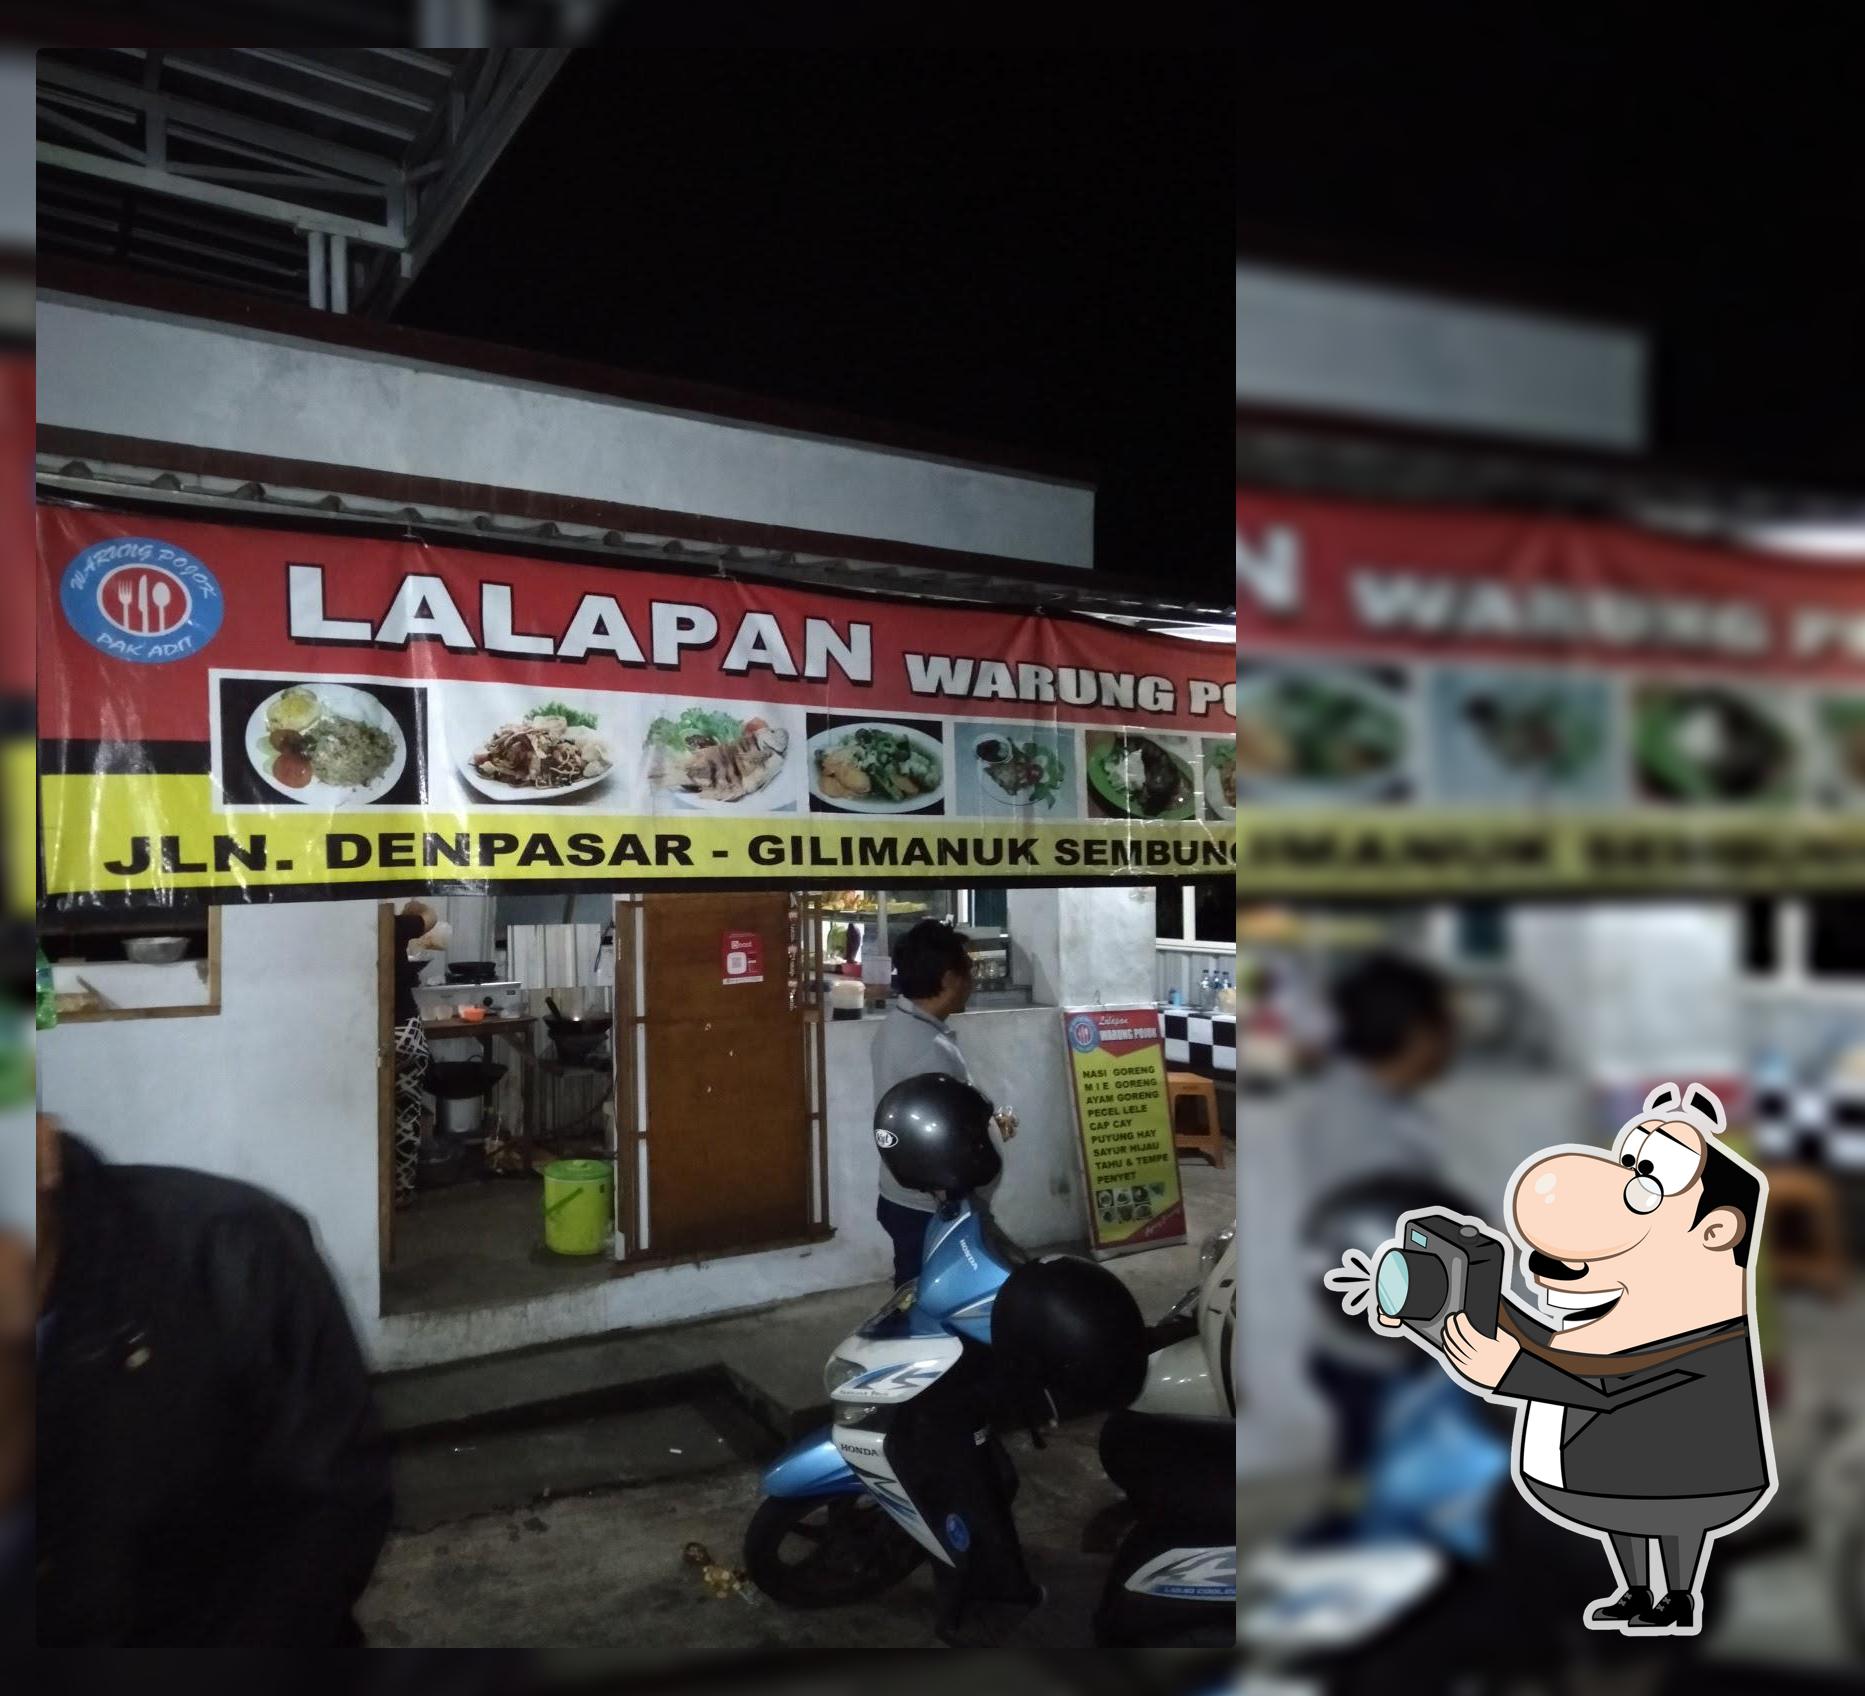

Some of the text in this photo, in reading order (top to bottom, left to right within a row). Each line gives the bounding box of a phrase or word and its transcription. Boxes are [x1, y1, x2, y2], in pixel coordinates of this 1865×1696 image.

[70, 543, 153, 591] WARUNG
[96, 632, 141, 656] PAK
[287, 564, 873, 684] LALAPAN
[905, 652, 1175, 714] WARUNG
[104, 834, 293, 877] JLN.
[325, 831, 693, 869] DENPASAR
[748, 833, 1039, 867] GILIMANUK
[1054, 838, 1236, 866] SEMBUN
[1082, 1065, 1156, 1079] NASI GORENG
[1115, 1078, 1158, 1089] GORENG
[1086, 1090, 1160, 1104] AYAM GORENG
[1087, 1104, 1147, 1117] PECEL LELE
[1089, 1119, 1132, 1131] CAP CAY
[1093, 1145, 1127, 1157] SAYUR
[1095, 1160, 1122, 1170] TAHU
[1136, 1153, 1169, 1165] TEMPE
[1097, 1171, 1136, 1184] PENYET
[840, 1443, 881, 1458] HONDA
